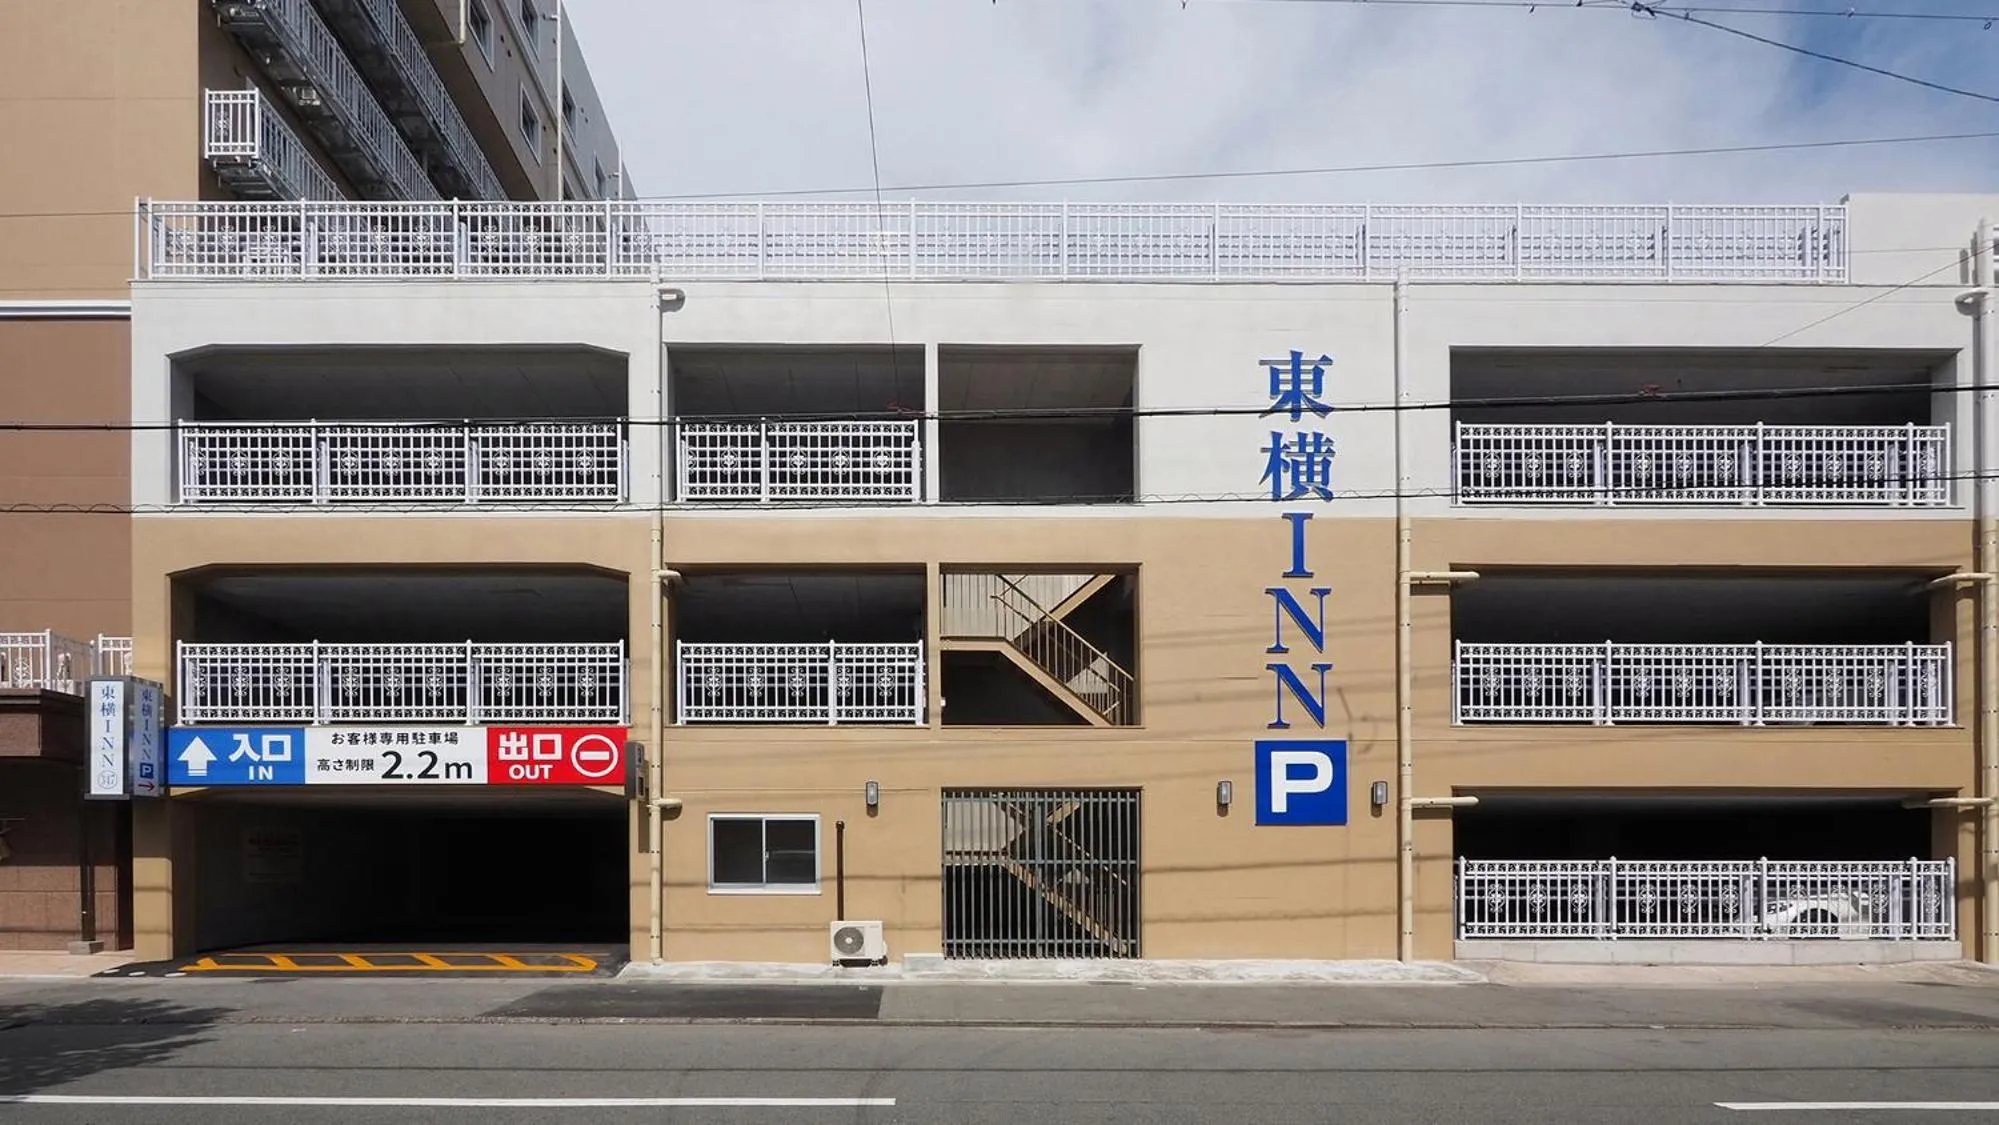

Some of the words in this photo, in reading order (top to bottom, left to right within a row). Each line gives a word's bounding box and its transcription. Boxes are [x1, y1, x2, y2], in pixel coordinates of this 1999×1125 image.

[1259, 350, 1335, 729] 東横INN
[101, 685, 116, 767] 東横INN
[331, 732, 459, 746] お客様専用駐車場
[229, 733, 292, 762] 入口
[498, 732, 562, 761] 出口
[248, 765, 273, 780] IN
[317, 758, 374, 772] 高さ制限
[381, 750, 473, 780] 2.2m
[509, 764, 553, 780] OUT
[1270, 750, 1334, 813] P
